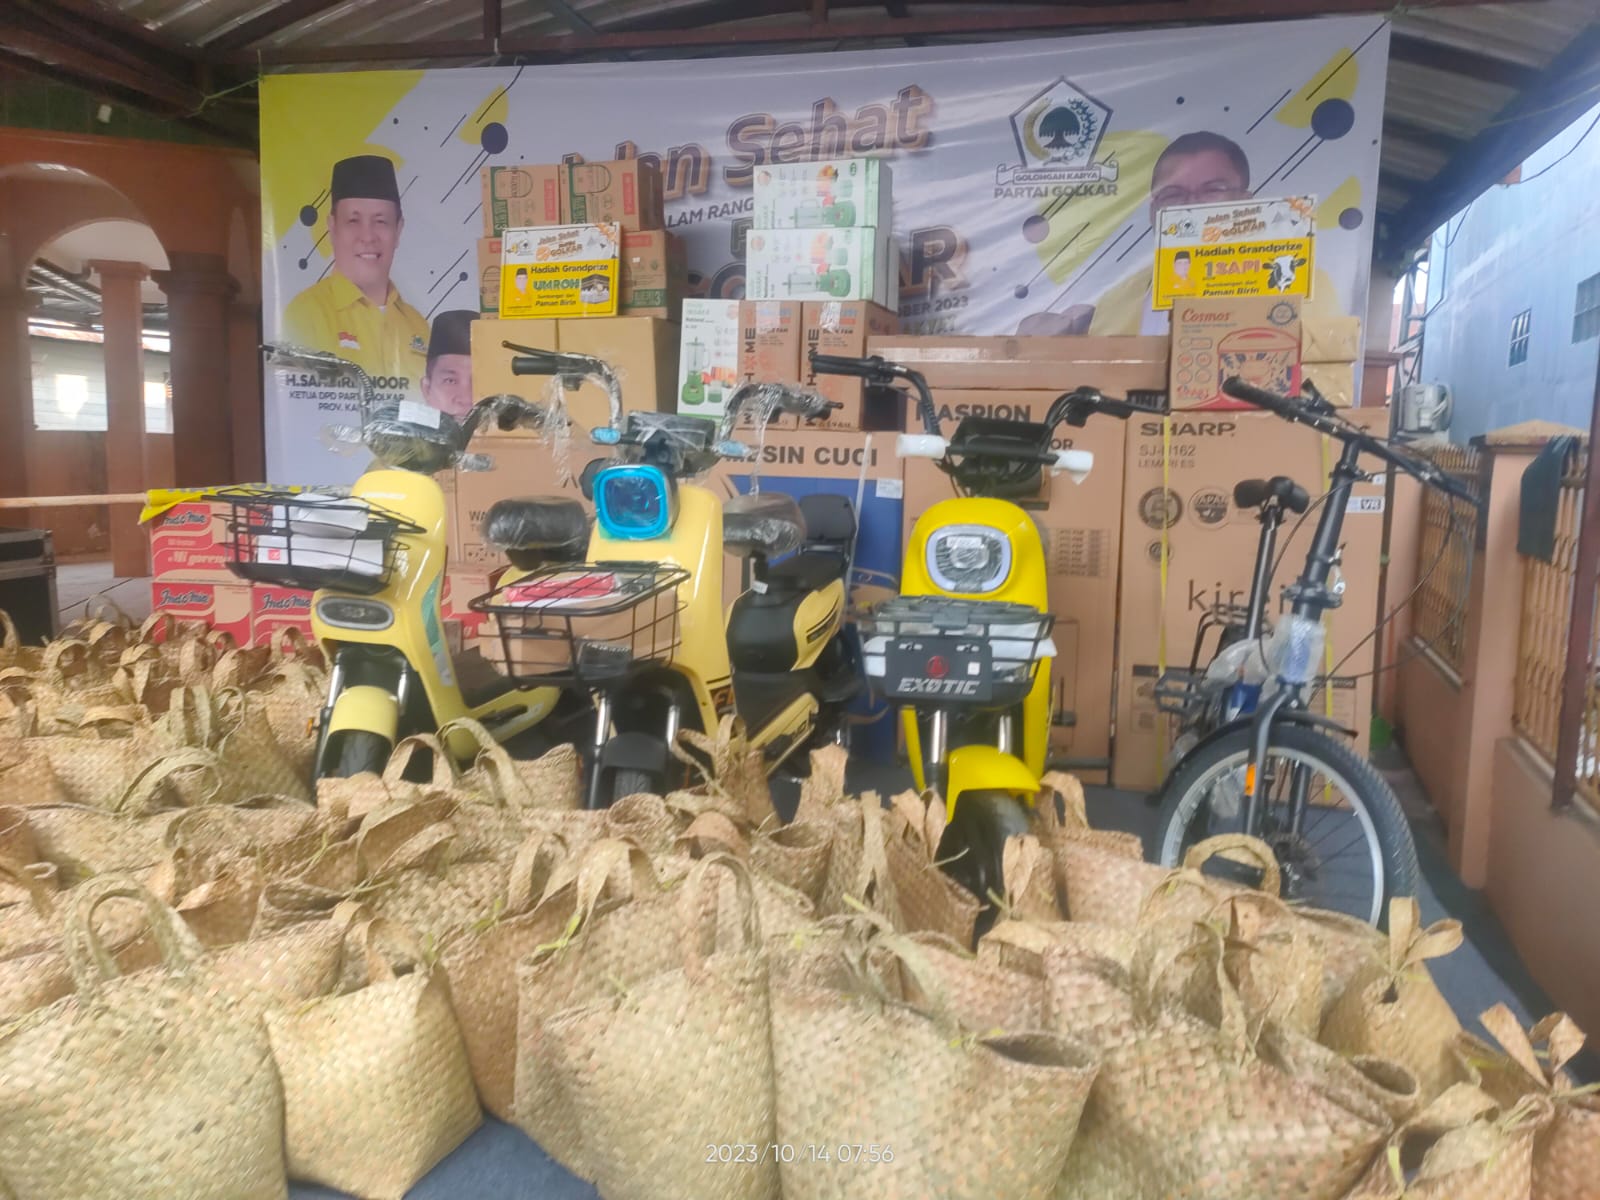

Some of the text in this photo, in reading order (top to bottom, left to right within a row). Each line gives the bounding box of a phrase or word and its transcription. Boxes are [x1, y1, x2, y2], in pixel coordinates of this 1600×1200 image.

[722, 83, 935, 187] Sehat
[1015, 171, 1098, 181] GOLONGAN KARYA
[994, 183, 1118, 199] PARTAI GOLKAR
[667, 197, 754, 228] LAM RANG
[1194, 242, 1303, 257] Hadiah Grandprize
[531, 263, 609, 273] Hadiah Grandprize
[1215, 259, 1261, 275] SAPI
[1202, 288, 1234, 297] Paman
[934, 296, 969, 313] 2023
[1181, 308, 1231, 322] Cosmos
[289, 391, 317, 399] KETUA
[318, 402, 341, 411] PROV.
[1140, 422, 1236, 437] SHARP
[813, 447, 878, 467] CUCI
[1188, 579, 1285, 614] kiri
[897, 677, 980, 695] EXOTIC
